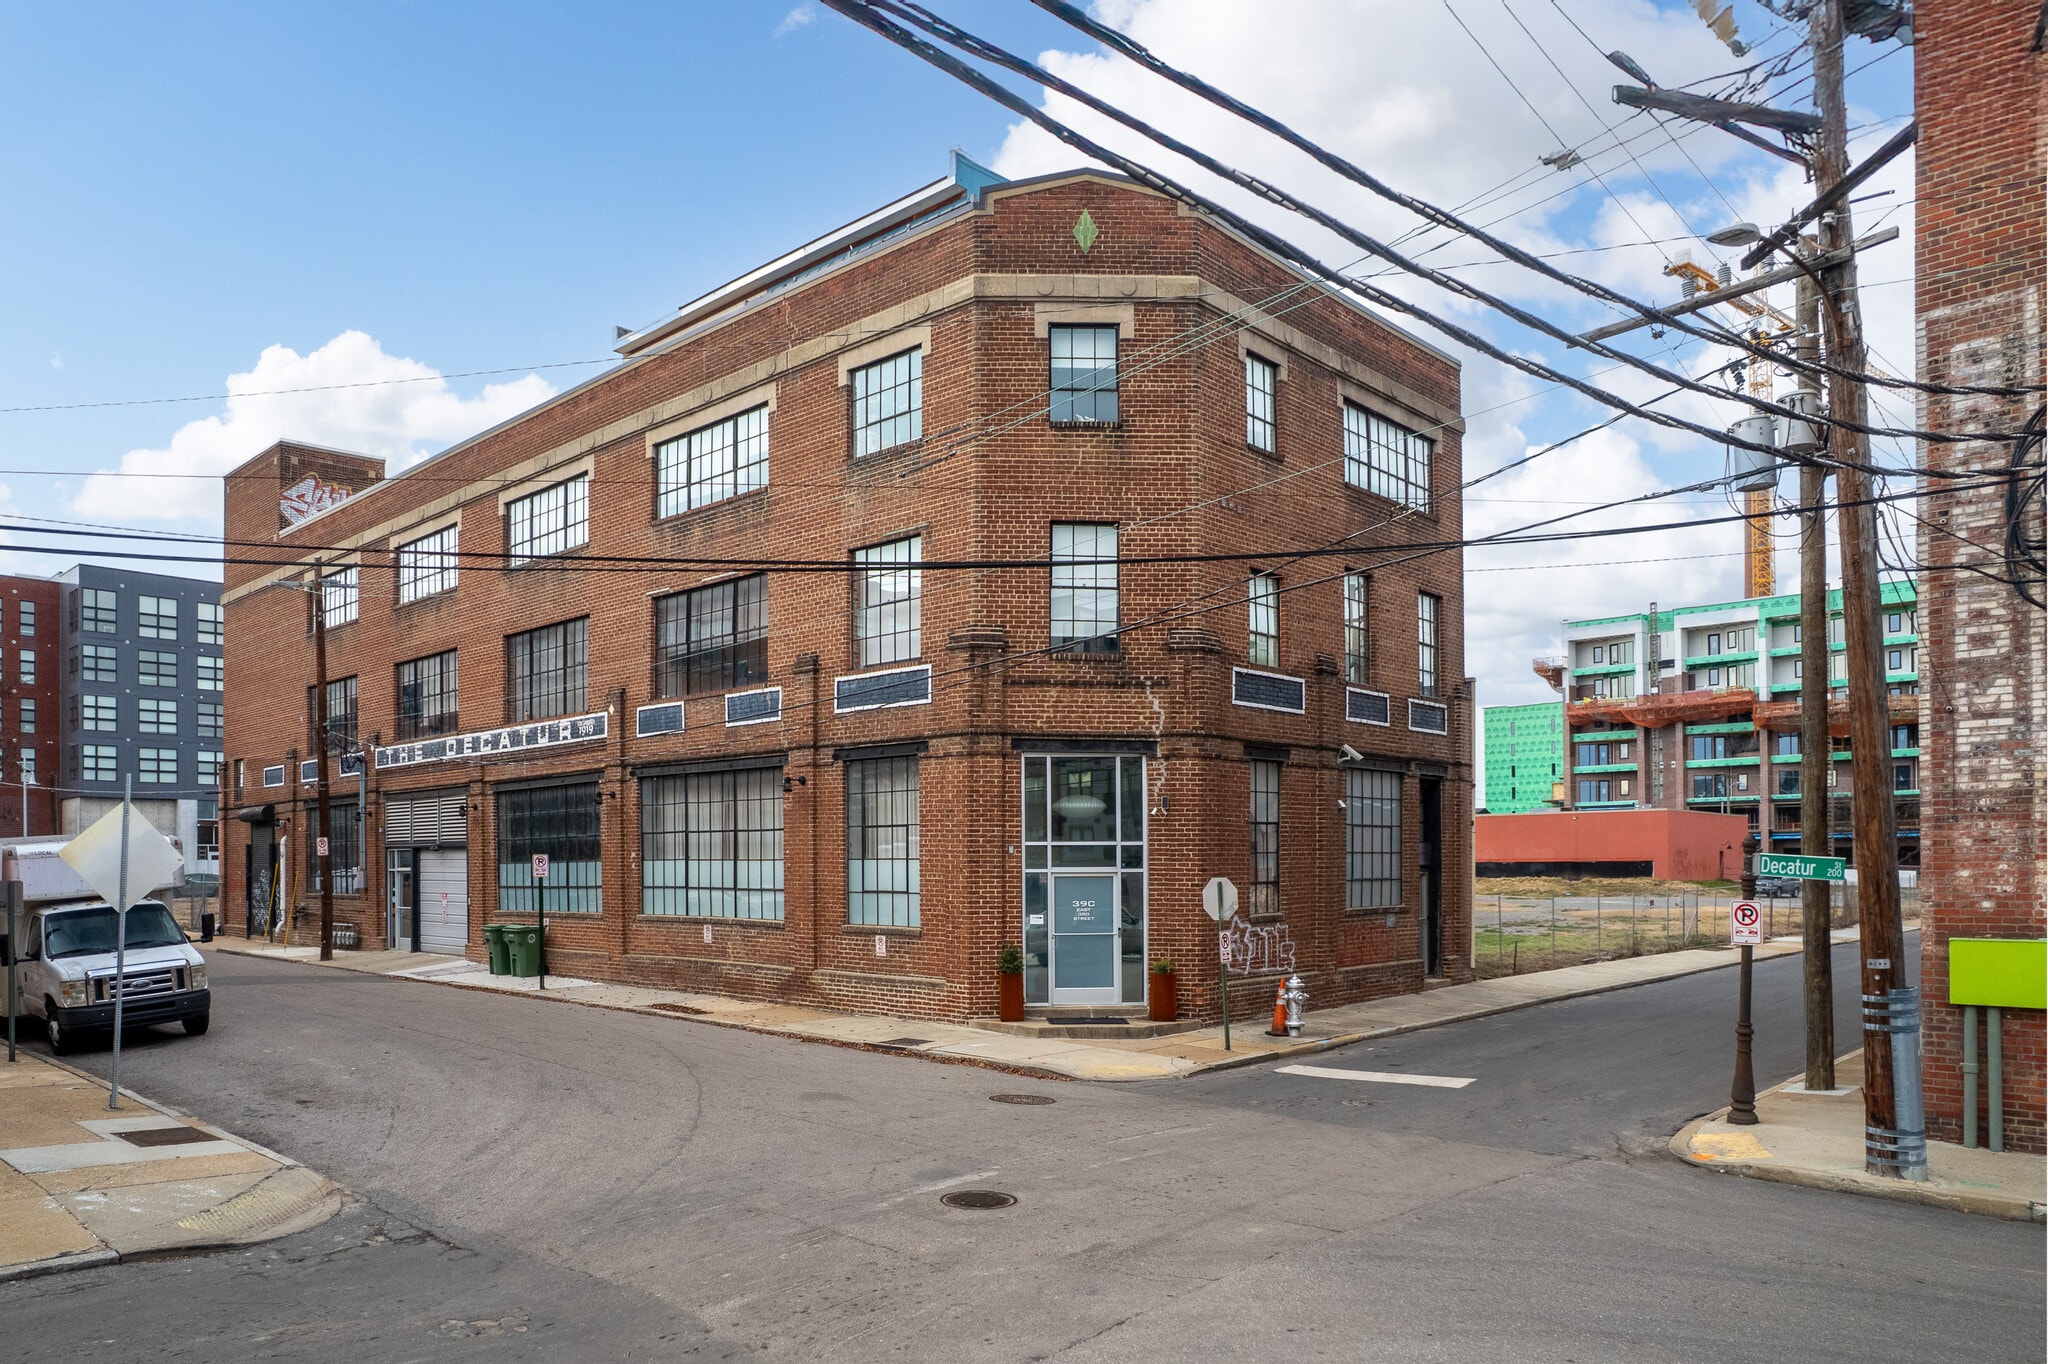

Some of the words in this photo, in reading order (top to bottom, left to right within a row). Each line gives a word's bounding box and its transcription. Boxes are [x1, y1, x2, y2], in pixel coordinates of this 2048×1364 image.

[579, 725, 594, 736] 1919
[386, 745, 423, 765] THE
[446, 722, 571, 757] DECATUR
[1760, 856, 1816, 876] Decatur
[1834, 861, 1842, 870] St
[1827, 868, 1842, 877] 200
